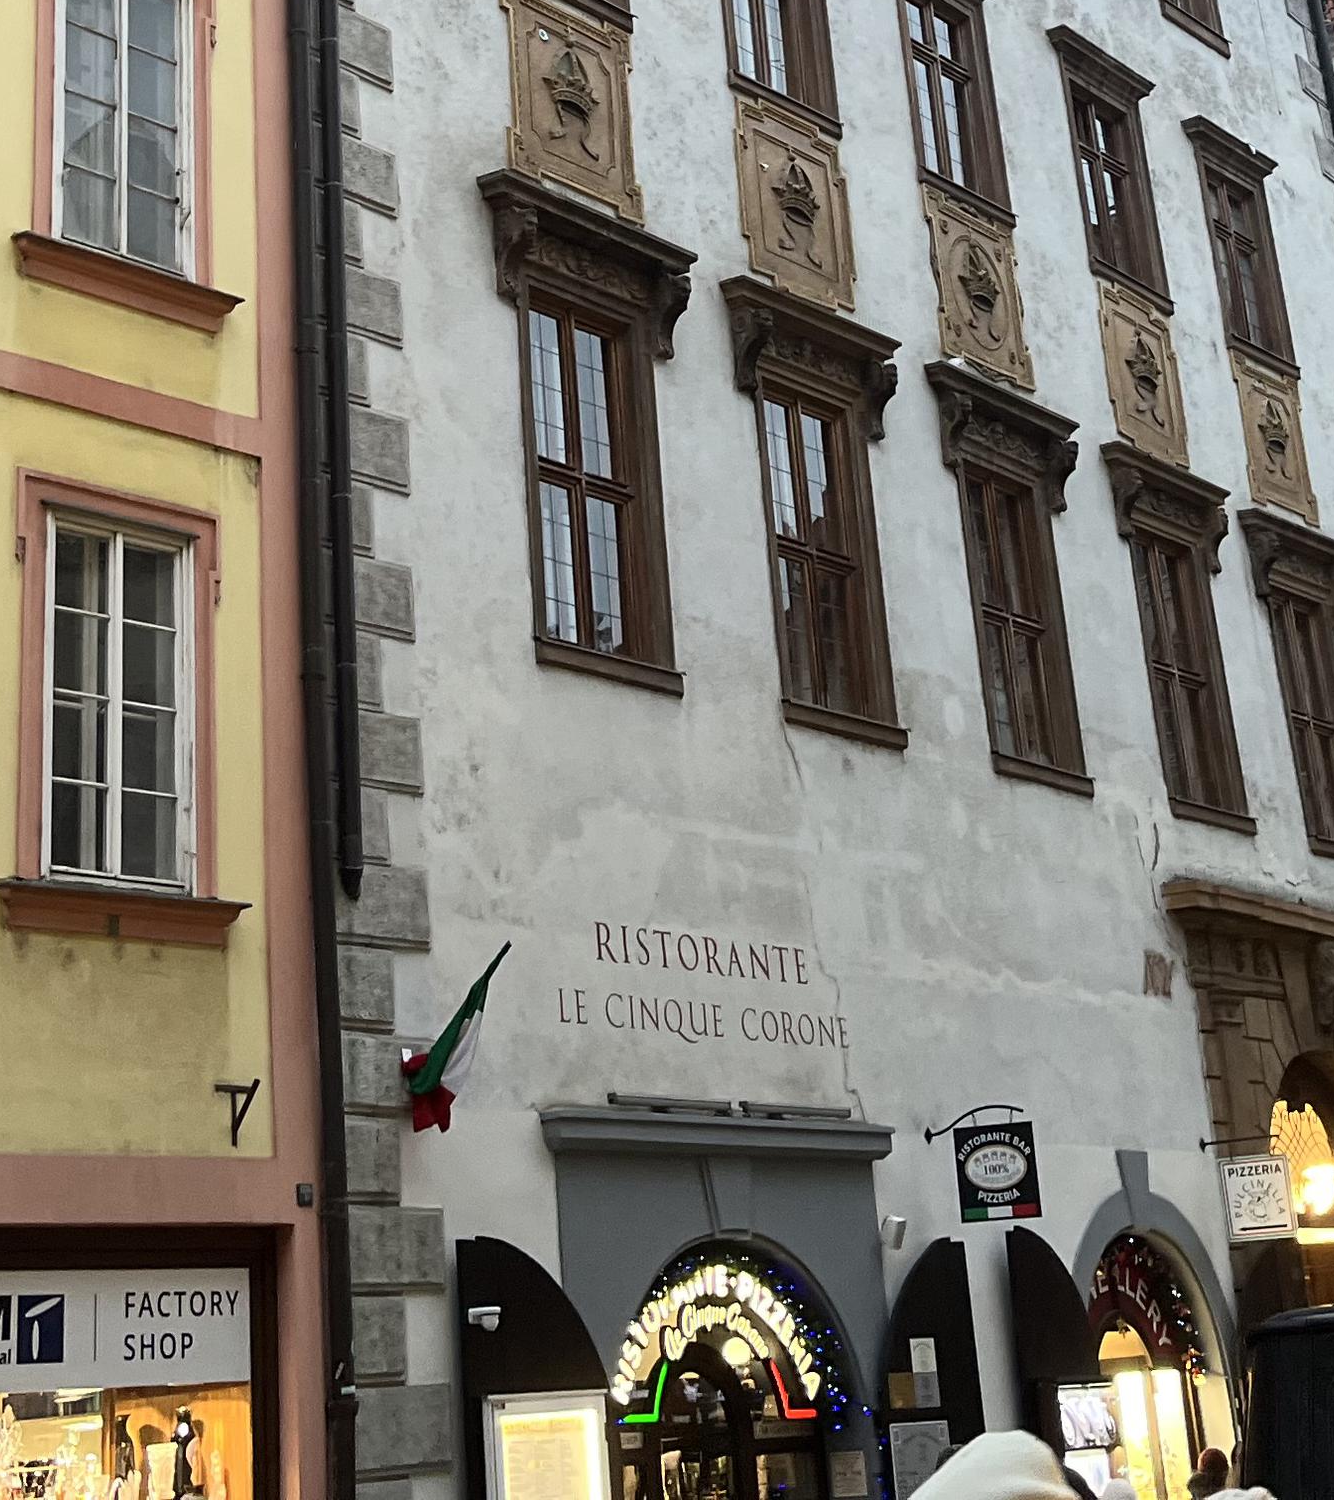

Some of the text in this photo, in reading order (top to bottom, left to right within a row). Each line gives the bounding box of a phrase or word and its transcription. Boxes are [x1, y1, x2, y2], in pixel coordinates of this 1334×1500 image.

[594, 921, 810, 986] RISTORANTE
[557, 987, 850, 1049] LE CINQUE CORONE
[957, 1131, 1031, 1162] RISTORANTE BAR
[983, 1163, 1010, 1176] 100%
[1227, 1163, 1282, 1179] PIZZERIA
[977, 1187, 1021, 1203] PIZZERIA
[124, 1290, 240, 1319] FACTORY
[123, 1332, 194, 1361] SHOP
